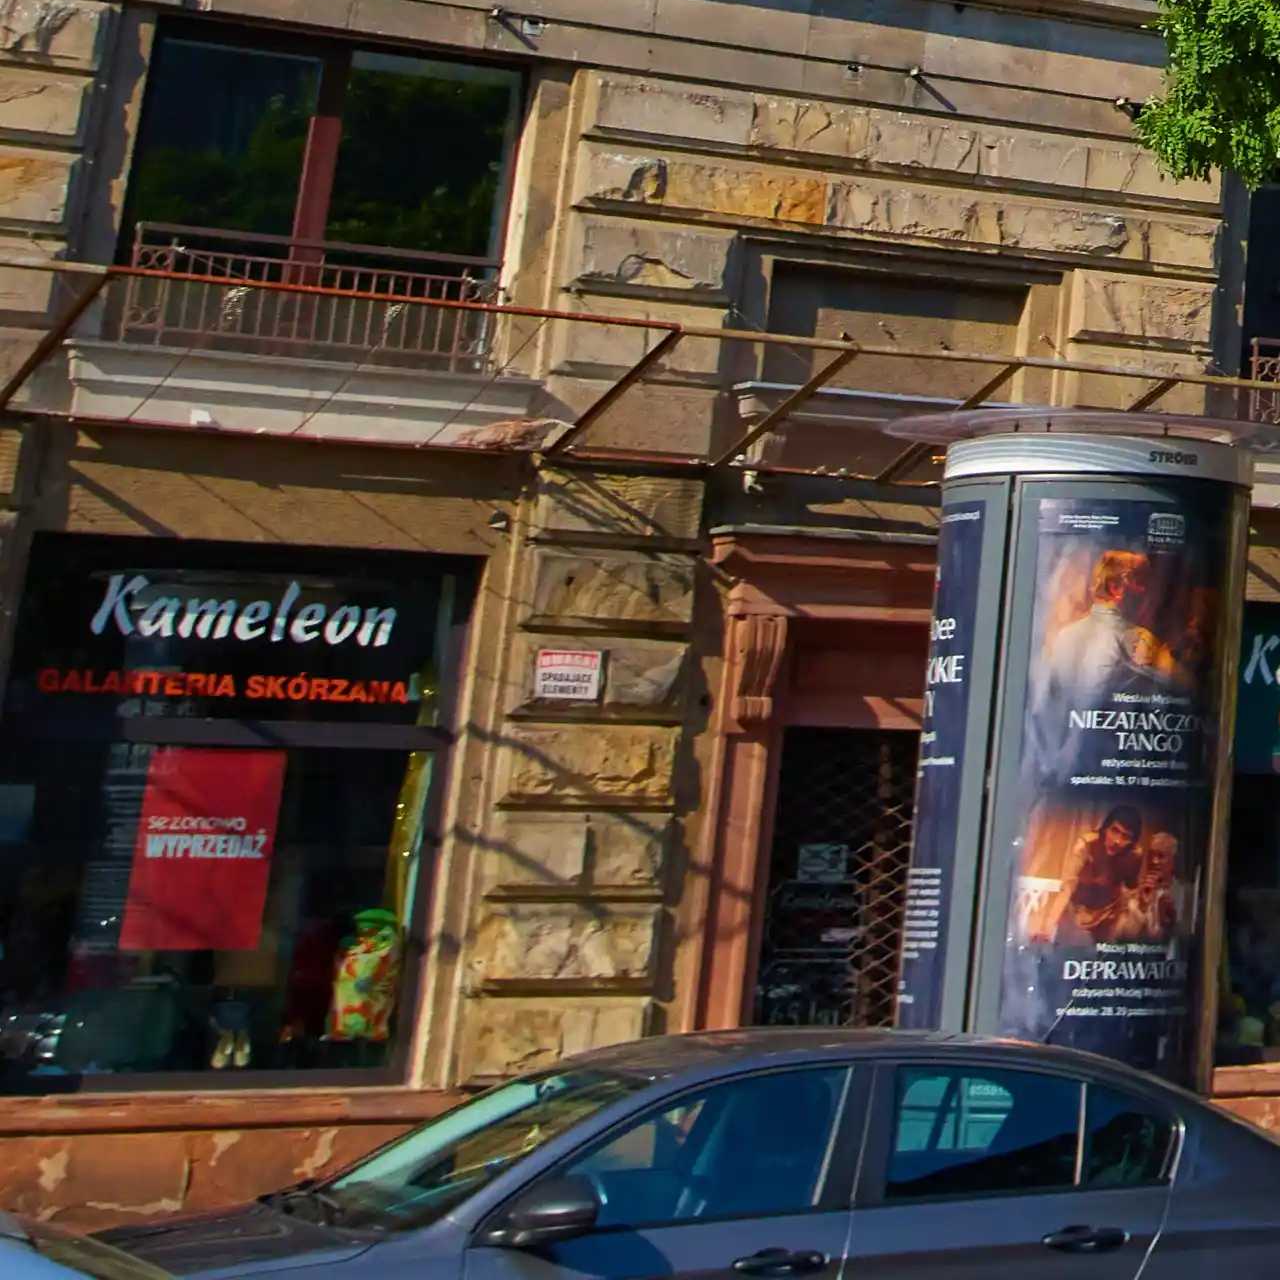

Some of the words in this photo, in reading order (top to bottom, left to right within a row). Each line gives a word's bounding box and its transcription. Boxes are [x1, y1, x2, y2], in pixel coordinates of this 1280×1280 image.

[90, 573, 398, 648] Kameleon
[37, 667, 237, 698] GALANTERIA
[244, 672, 408, 705] SKÓRZANA
[1115, 731, 1183, 753] TANGO
[145, 828, 268, 859] WYPRZEDAŻ
